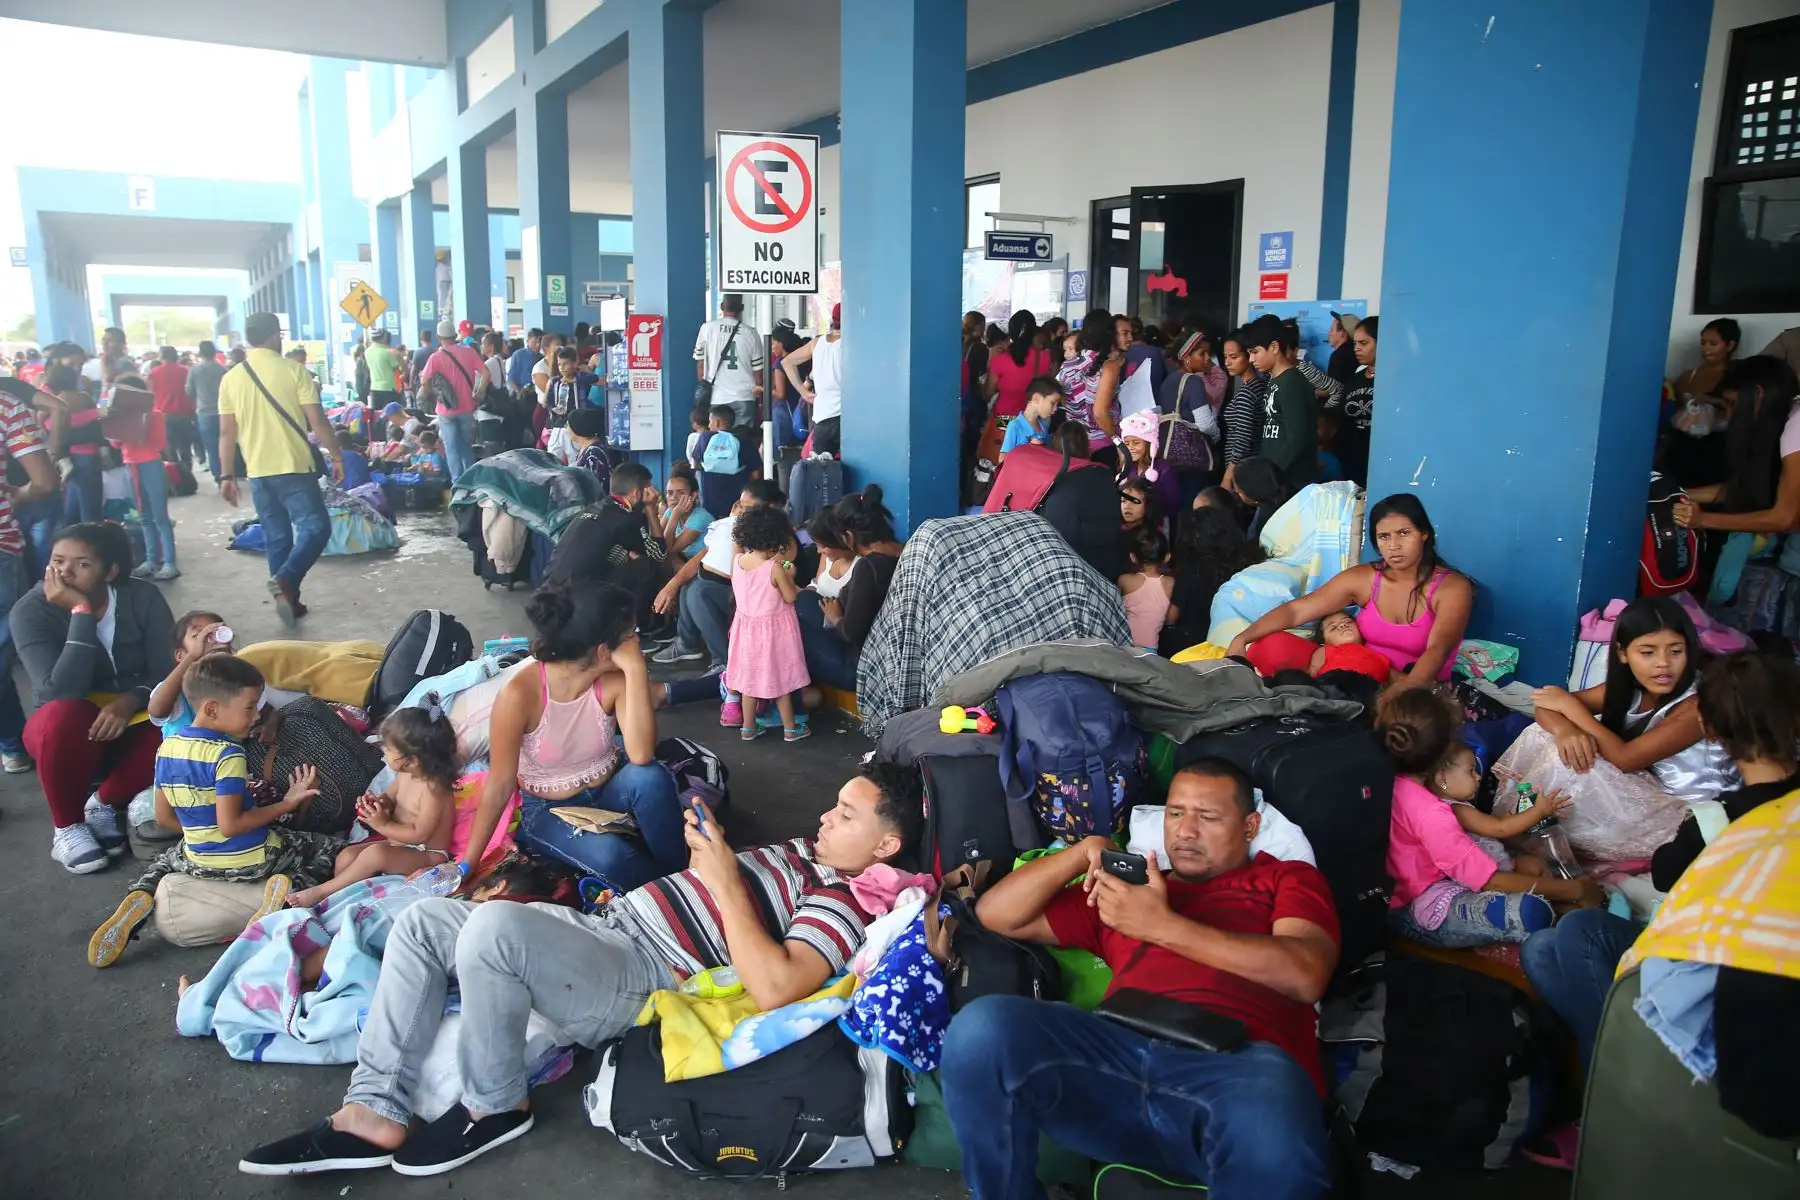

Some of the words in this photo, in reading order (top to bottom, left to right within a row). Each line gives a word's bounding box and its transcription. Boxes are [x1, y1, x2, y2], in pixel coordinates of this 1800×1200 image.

[754, 160, 788, 214] E
[135, 188, 148, 206] F
[754, 242, 783, 262] NO
[992, 243, 1029, 253] Aduanas
[727, 270, 810, 285] ESTACIONAR
[552, 278, 561, 291] S
[424, 303, 430, 312] S
[720, 324, 741, 334] FAVE
[722, 341, 737, 369] 4
[633, 381, 658, 389] BEBE
[719, 1146, 755, 1157] JUVENTUS
